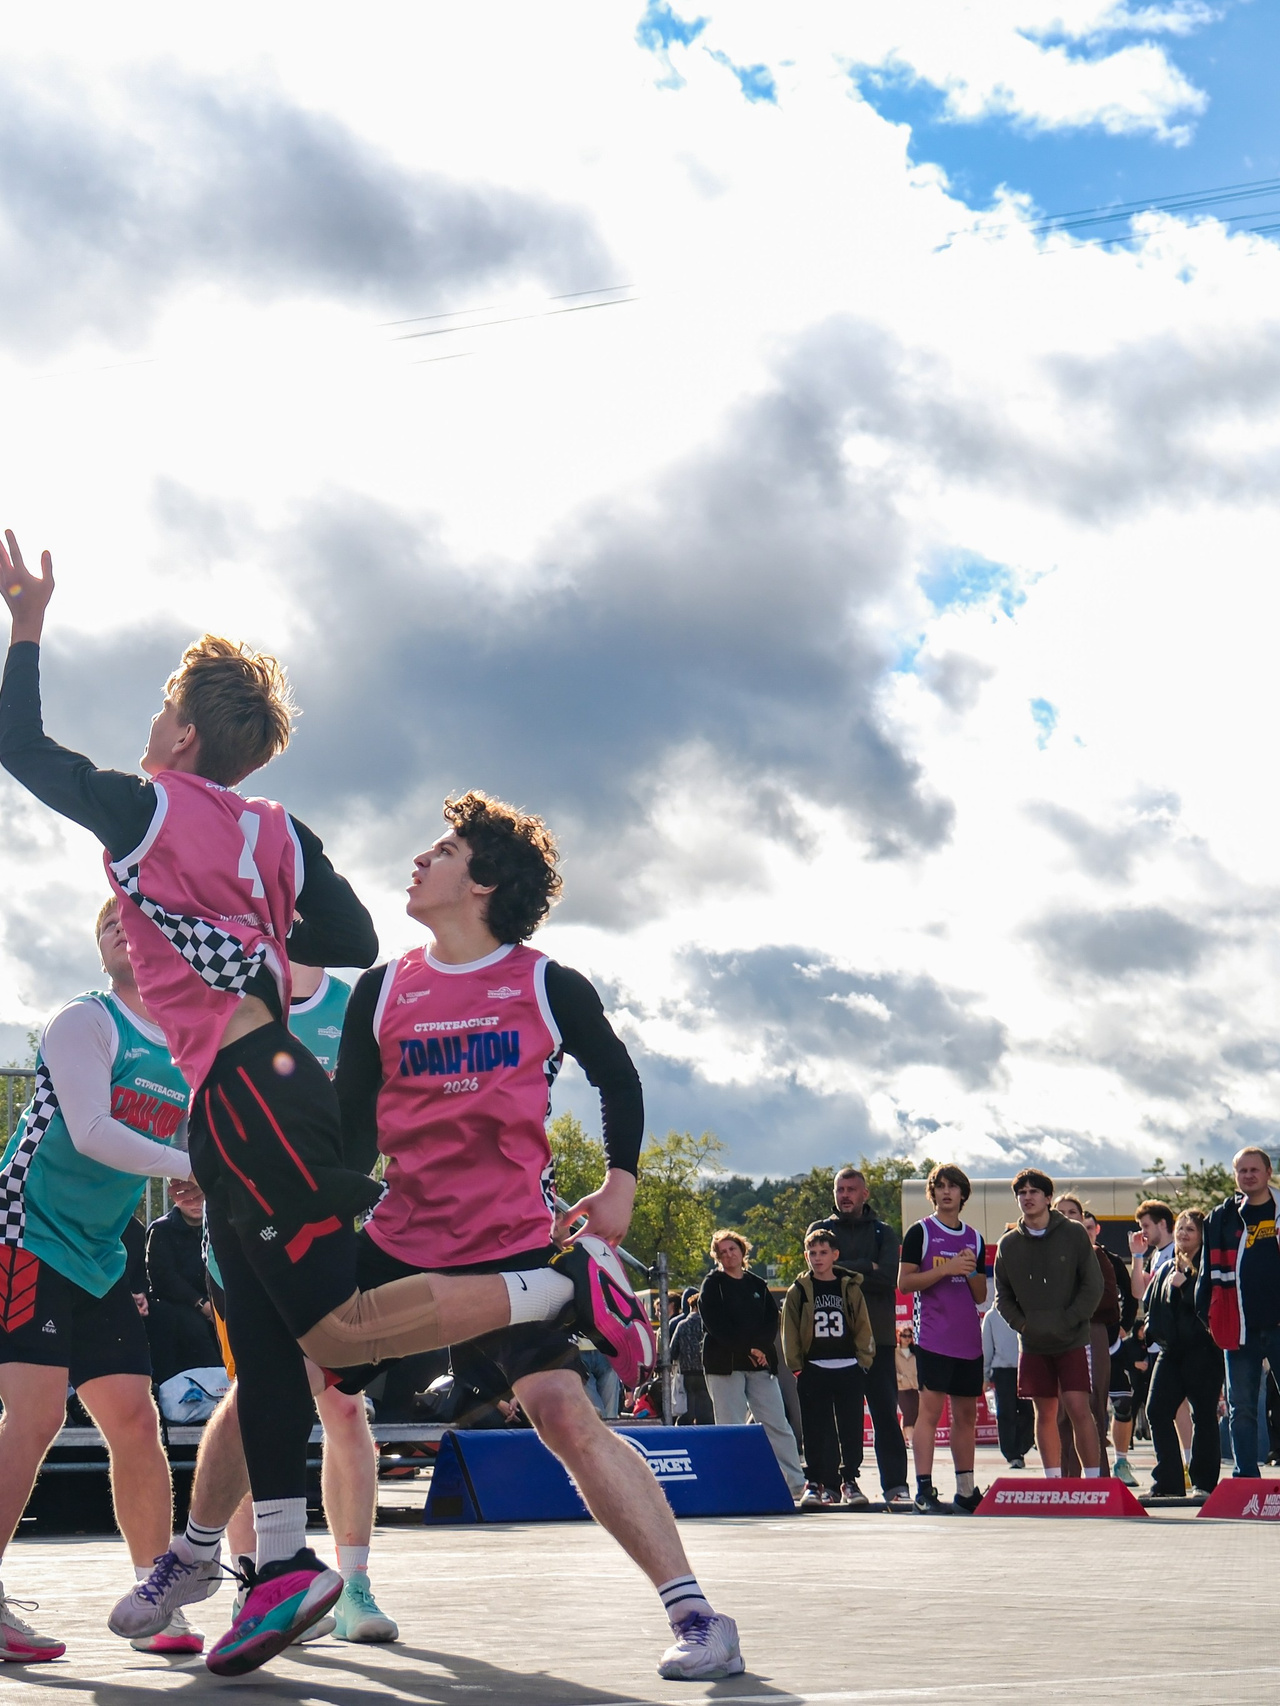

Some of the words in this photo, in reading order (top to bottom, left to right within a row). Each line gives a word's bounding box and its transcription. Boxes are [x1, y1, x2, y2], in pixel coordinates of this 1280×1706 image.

[413, 1016, 499, 1033] СТРИТБАСКЕТ
[398, 1030, 520, 1078] ГРАН-ПРИ
[134, 1077, 186, 1103] СТРИТБАСКЕТ
[443, 1076, 479, 1095] 2026
[814, 1294, 844, 1310] AME
[814, 1311, 844, 1338] 23
[994, 1490, 1110, 1504] STREETBASKET
[1260, 1505, 1280, 1517] СПОР
